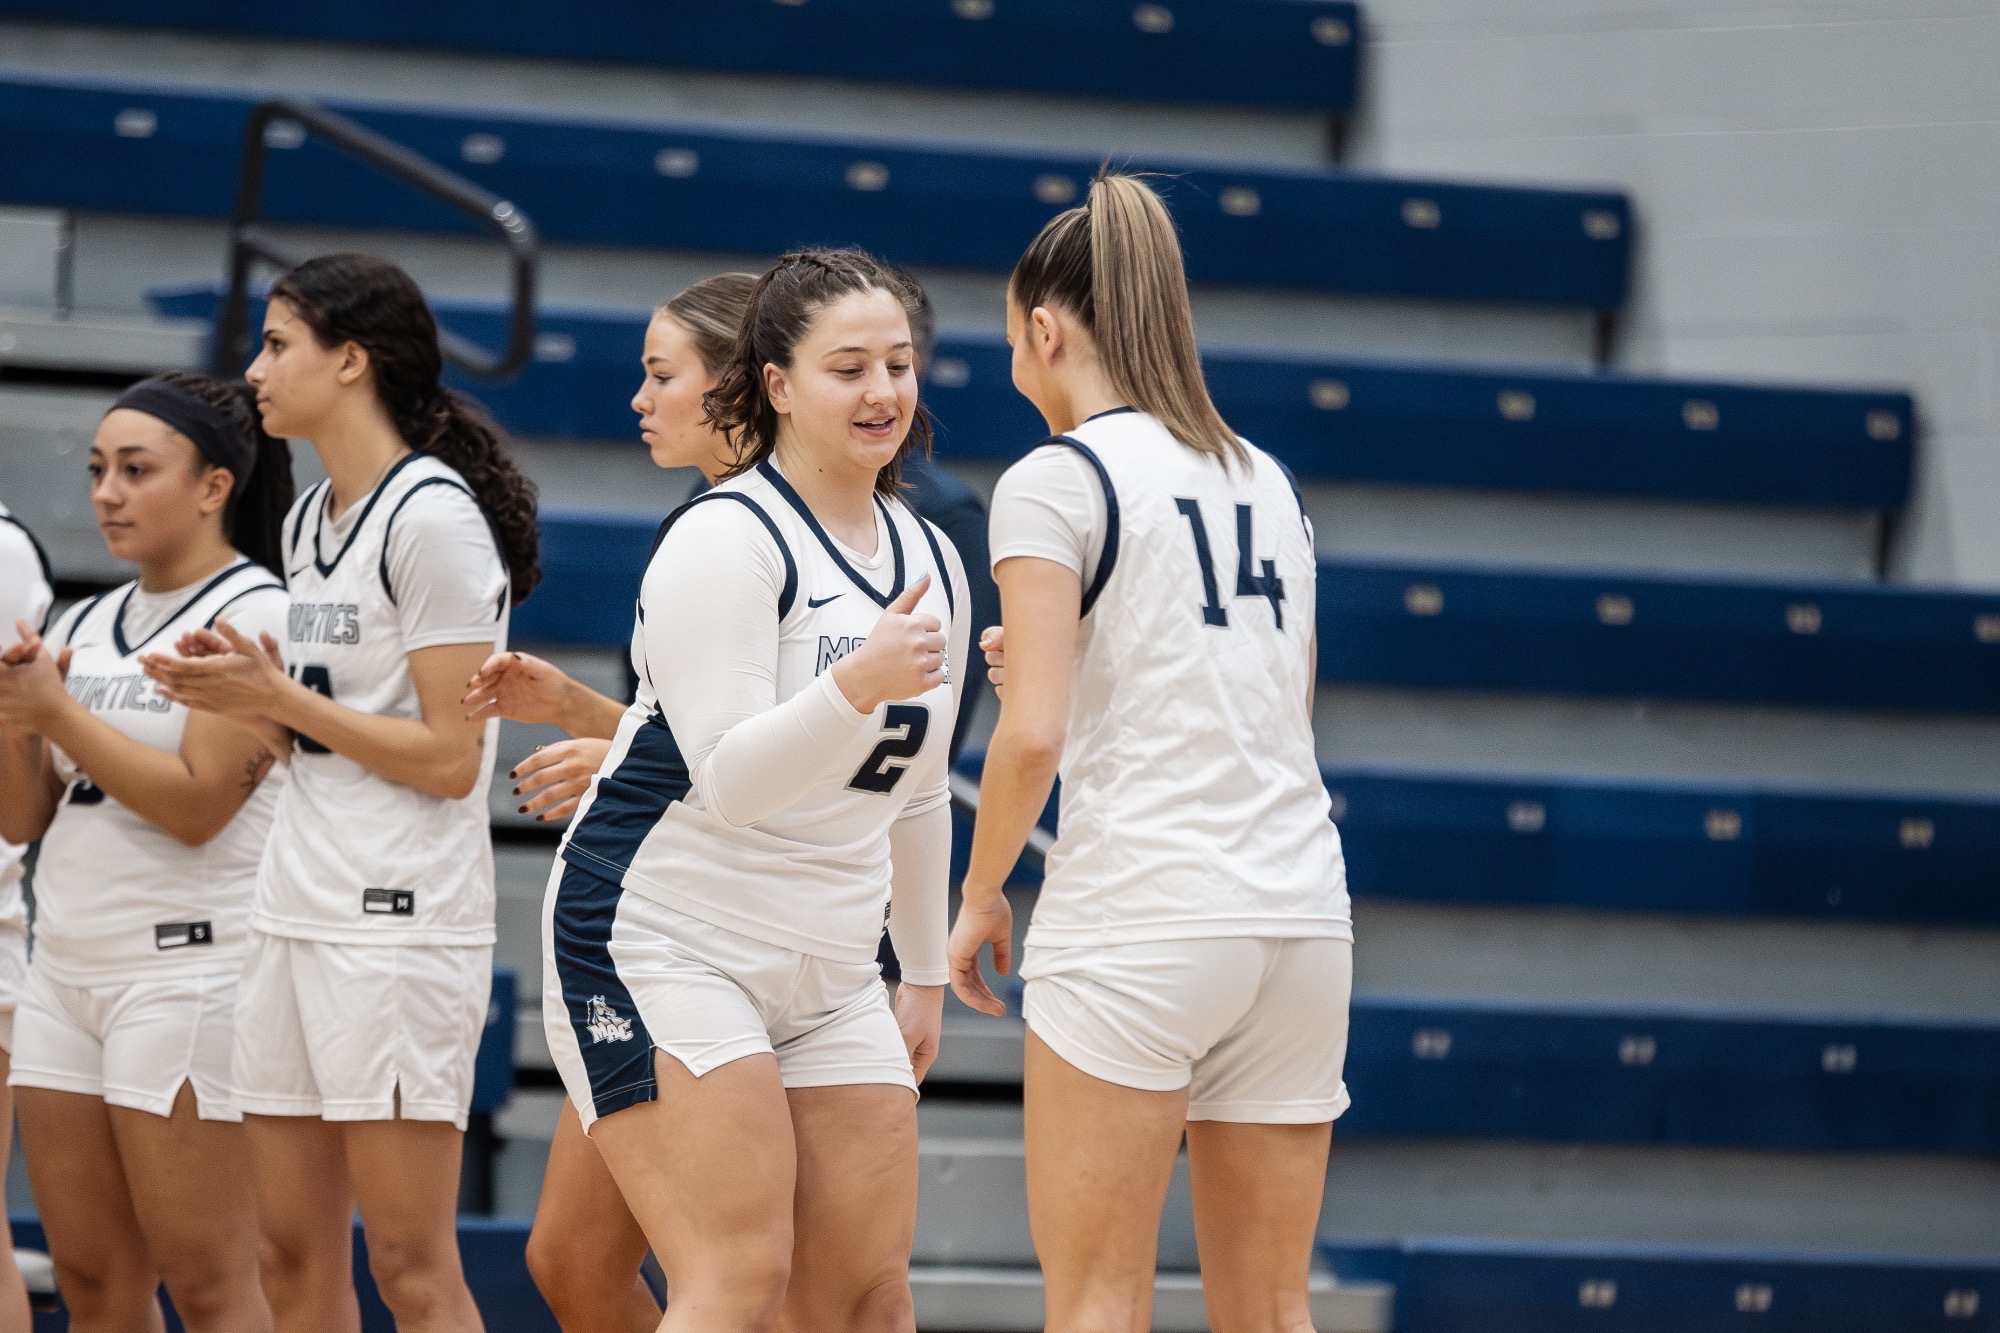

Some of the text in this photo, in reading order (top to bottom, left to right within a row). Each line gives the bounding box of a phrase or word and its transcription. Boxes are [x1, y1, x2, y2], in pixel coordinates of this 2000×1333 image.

[1172, 495, 1288, 634] 14
[844, 701, 931, 796] 2
[586, 1019, 634, 1043] MAC
